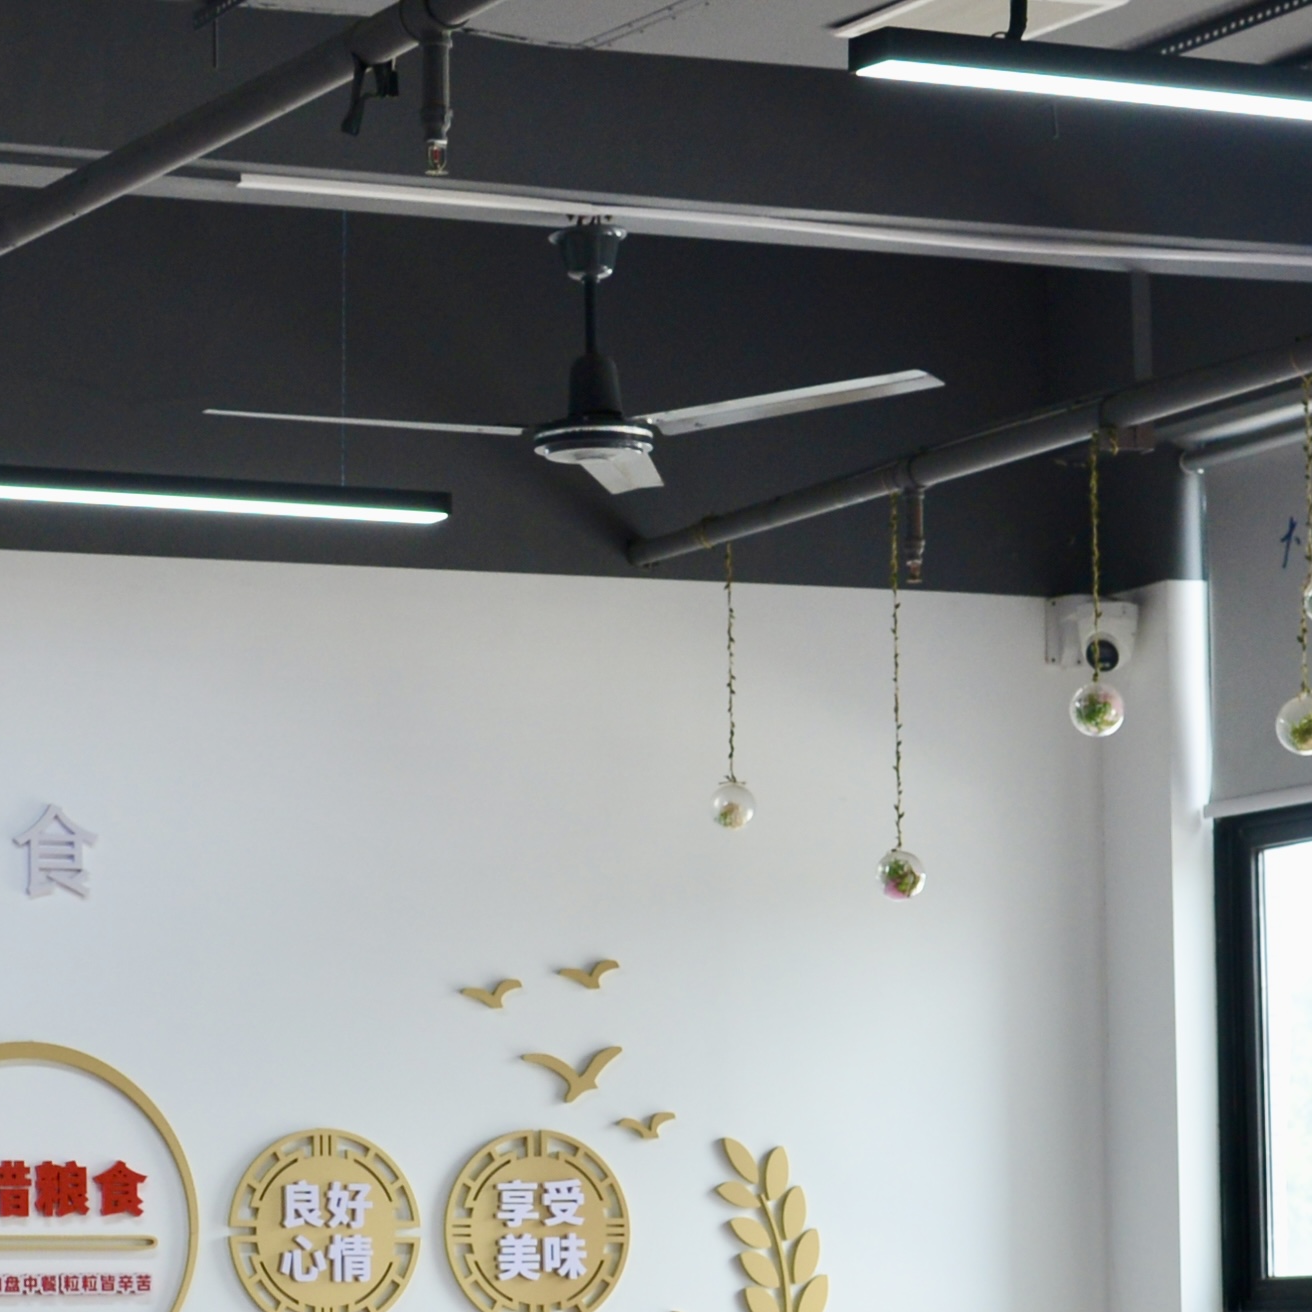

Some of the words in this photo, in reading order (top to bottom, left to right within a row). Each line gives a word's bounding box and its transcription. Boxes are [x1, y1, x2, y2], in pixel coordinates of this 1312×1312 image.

[282, 1180, 374, 1229] 良好
[497, 1179, 586, 1228] 享受
[280, 1234, 374, 1283] 心情
[497, 1233, 588, 1281] 美味
